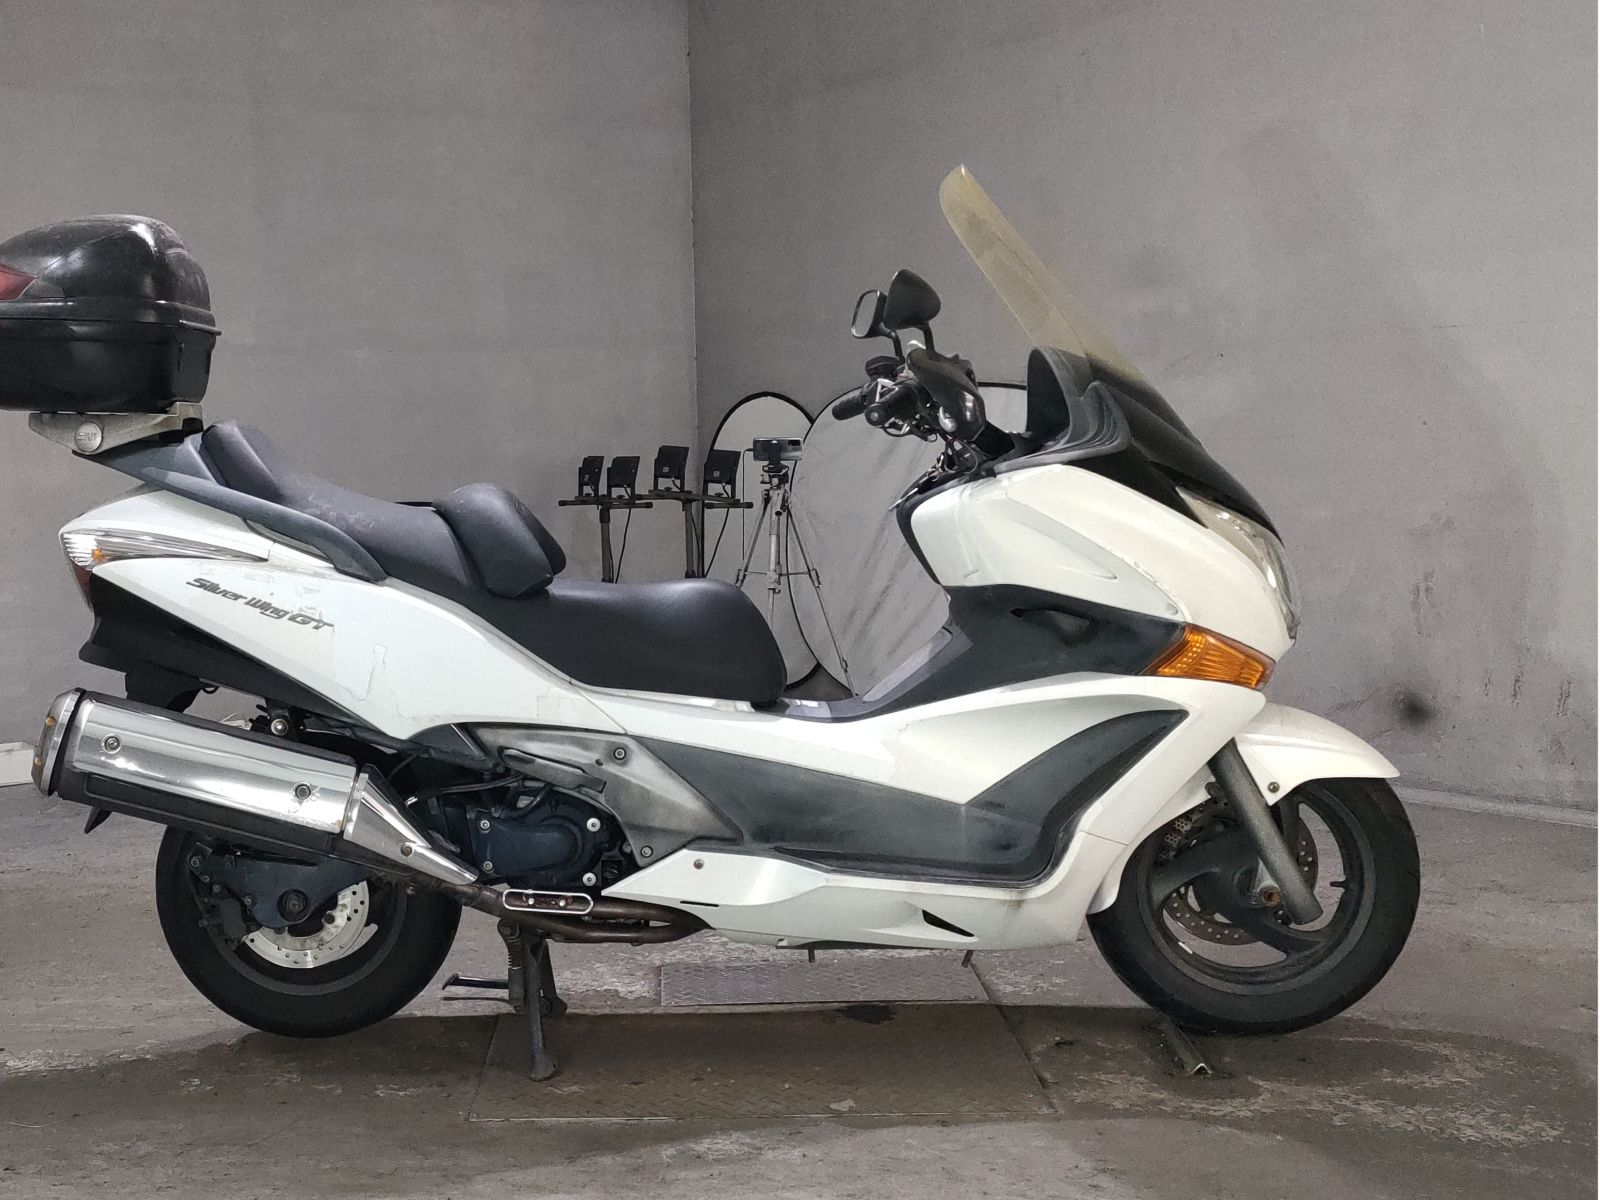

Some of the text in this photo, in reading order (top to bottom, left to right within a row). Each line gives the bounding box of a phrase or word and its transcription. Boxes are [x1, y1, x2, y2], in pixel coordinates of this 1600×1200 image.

[186, 577, 335, 630] Silver Wing GT
